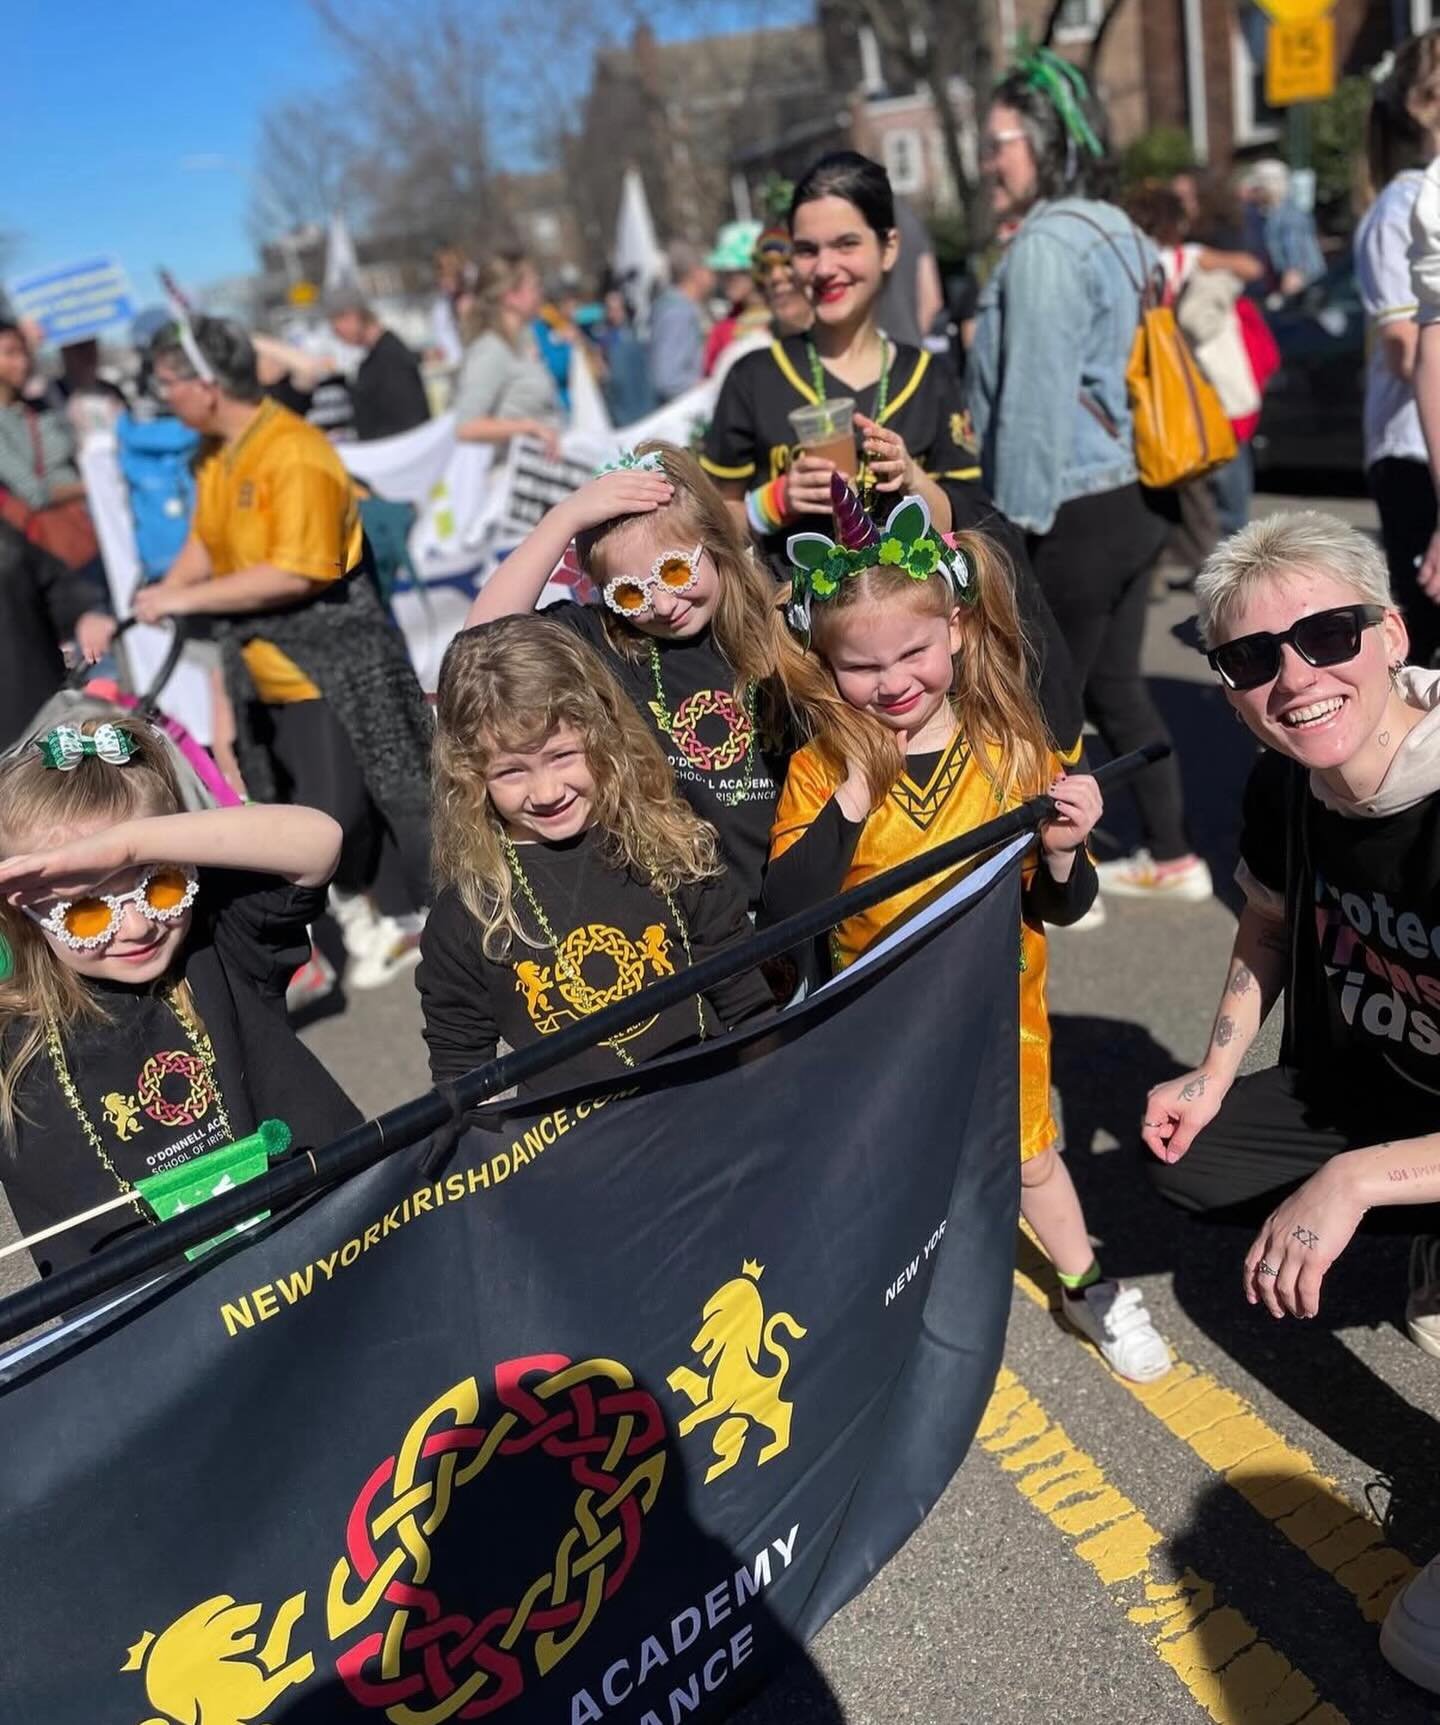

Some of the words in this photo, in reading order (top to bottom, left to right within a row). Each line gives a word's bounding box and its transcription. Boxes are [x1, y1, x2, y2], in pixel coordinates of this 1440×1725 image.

[146, 1129, 206, 1166] O'DONNELL
[151, 1153, 192, 1175] SCHOOL
[192, 1143, 206, 1155] OF
[207, 1128, 231, 1147] IRISH
[885, 1254, 920, 1307] NEW
[924, 1219, 948, 1260] YOR
[570, 1523, 800, 1725] ACADEMY
